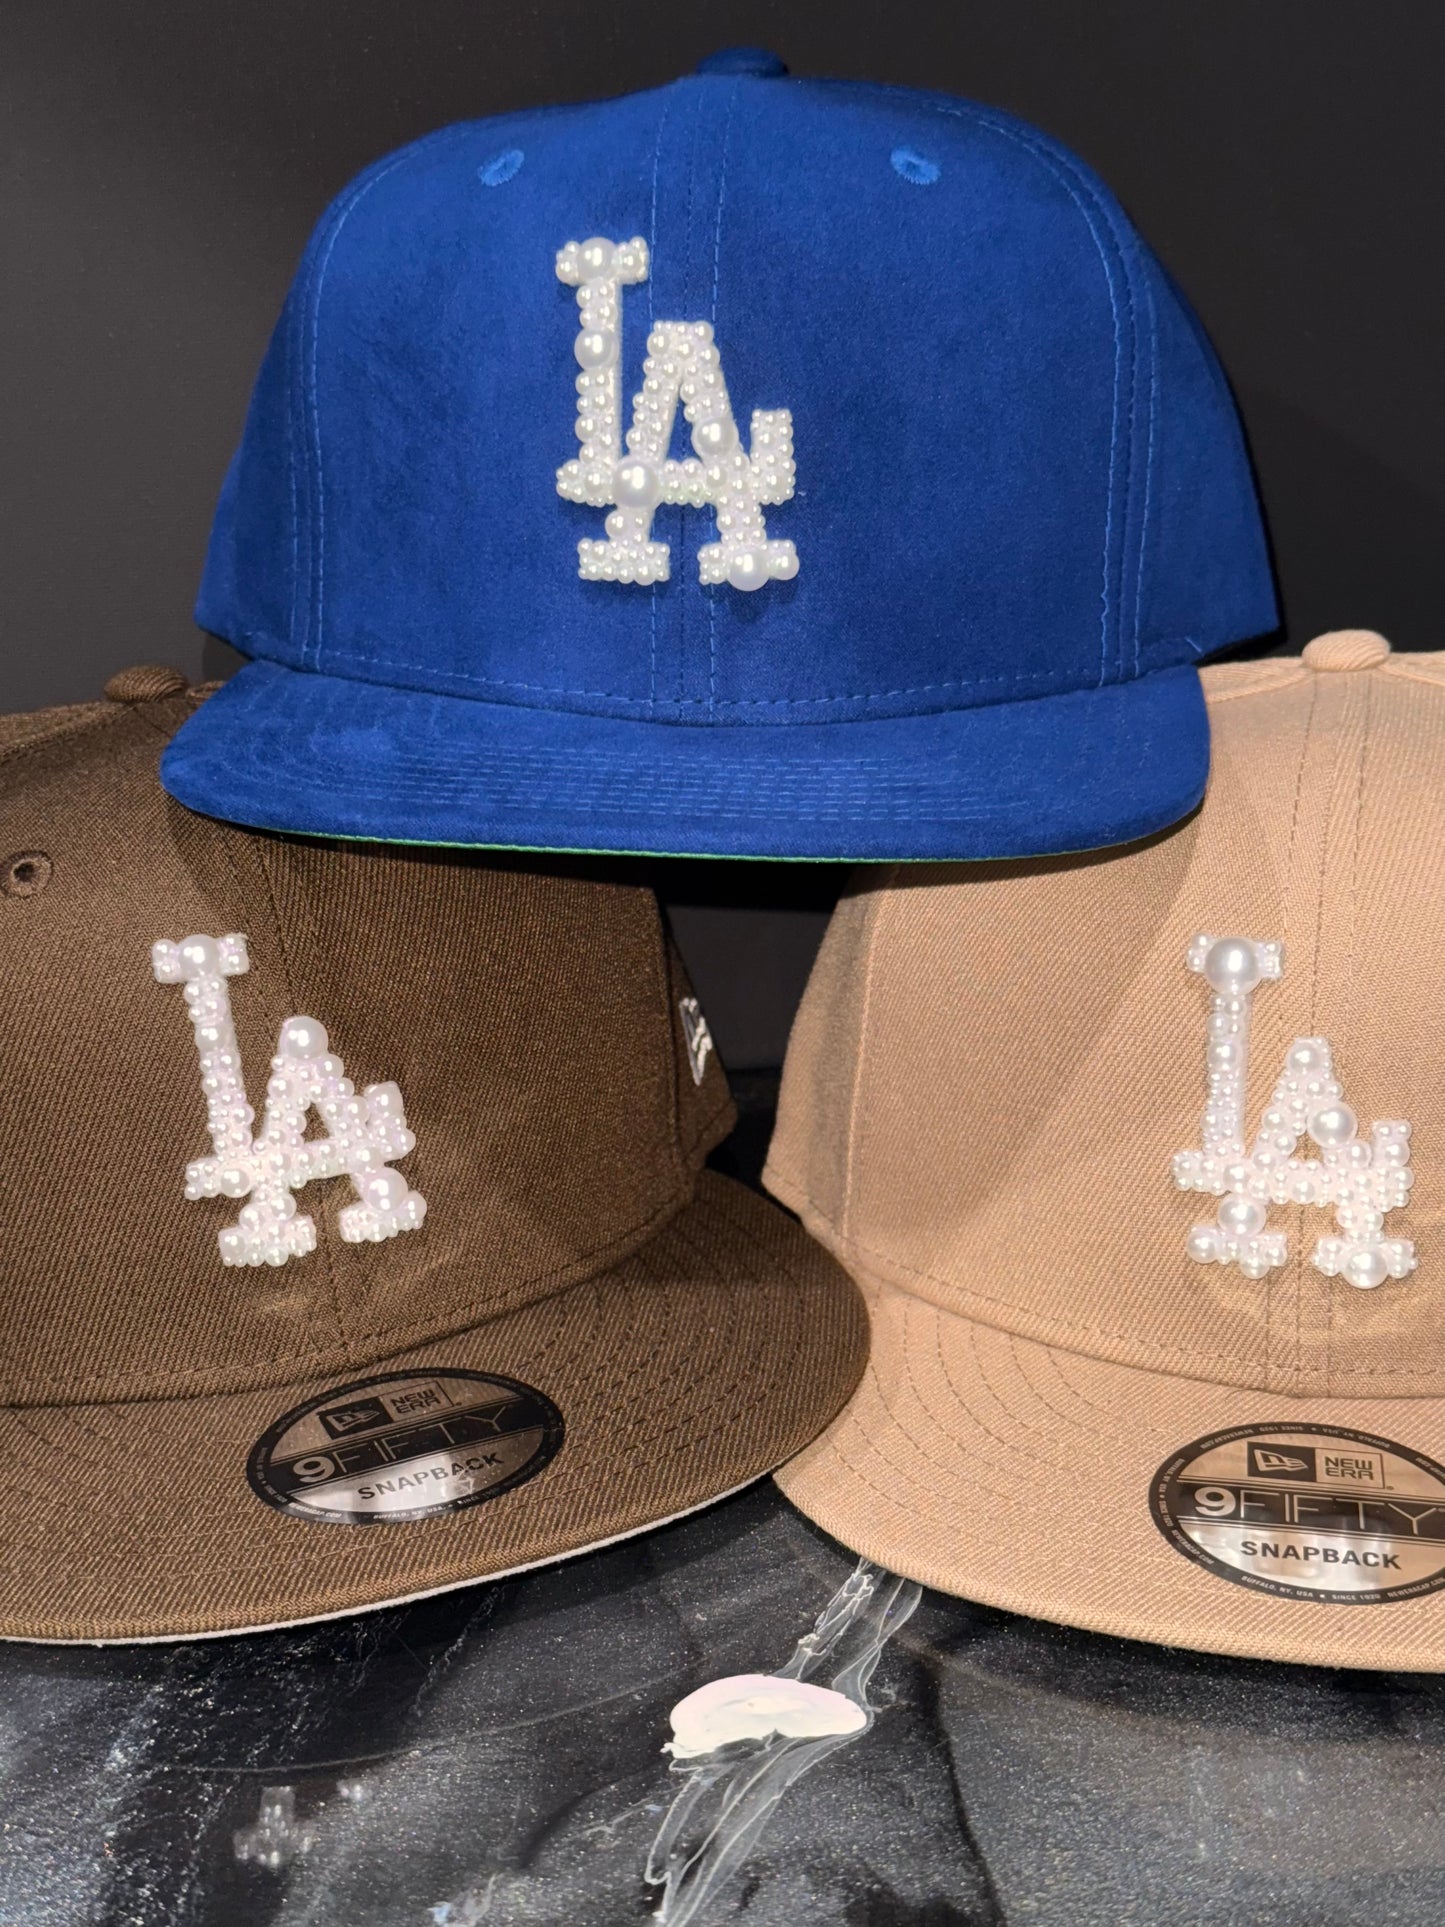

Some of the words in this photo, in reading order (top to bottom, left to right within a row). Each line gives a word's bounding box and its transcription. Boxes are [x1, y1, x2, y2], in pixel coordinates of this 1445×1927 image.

[556, 236, 800, 592] LA
[152, 933, 428, 1267] LA
[1173, 931, 1418, 1289] LA
[389, 1388, 436, 1407] NEW
[395, 1397, 442, 1414] ERA
[293, 1405, 506, 1484] 9FIFTY
[1324, 1455, 1373, 1471] NEW
[357, 1451, 504, 1501] SNAPBACK
[1324, 1466, 1374, 1481] ERA
[1193, 1486, 1438, 1536] 9FIFTY
[1240, 1540, 1403, 1571] SNAPBACK
[1296, 1589, 1315, 1598] USA
